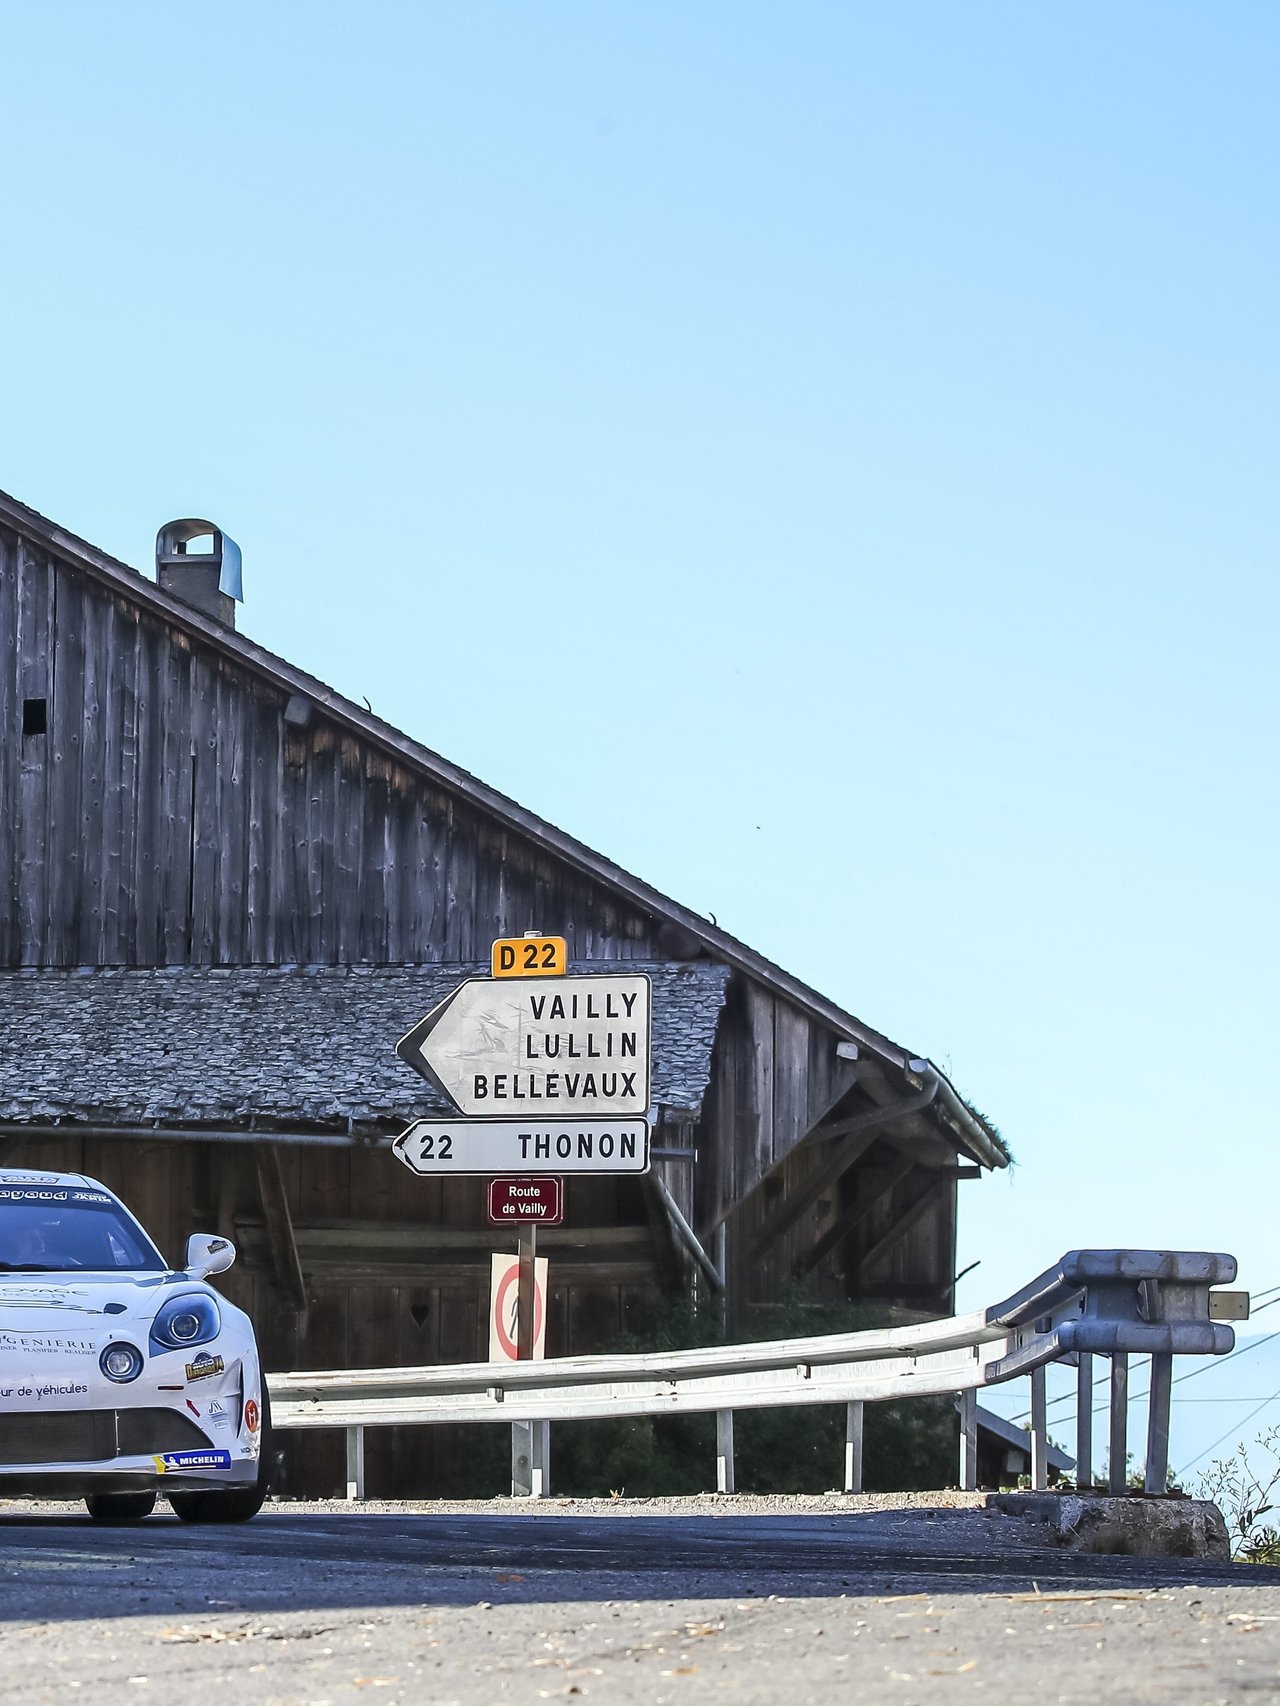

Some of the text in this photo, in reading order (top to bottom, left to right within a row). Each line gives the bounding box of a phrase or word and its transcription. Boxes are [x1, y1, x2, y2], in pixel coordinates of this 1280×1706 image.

[500, 944, 556, 970] D 22
[530, 993, 637, 1019] VAILLY
[526, 1033, 636, 1058] LULLIN
[474, 1072, 636, 1099] BELLEVAUX
[420, 1133, 636, 1159] 22 THONON
[509, 1186, 541, 1197] Route
[502, 1203, 547, 1216] de Vailly
[18, 1385, 33, 1397] de
[36, 1383, 88, 1397] véhicules
[180, 1456, 224, 1465] MICHELIN
